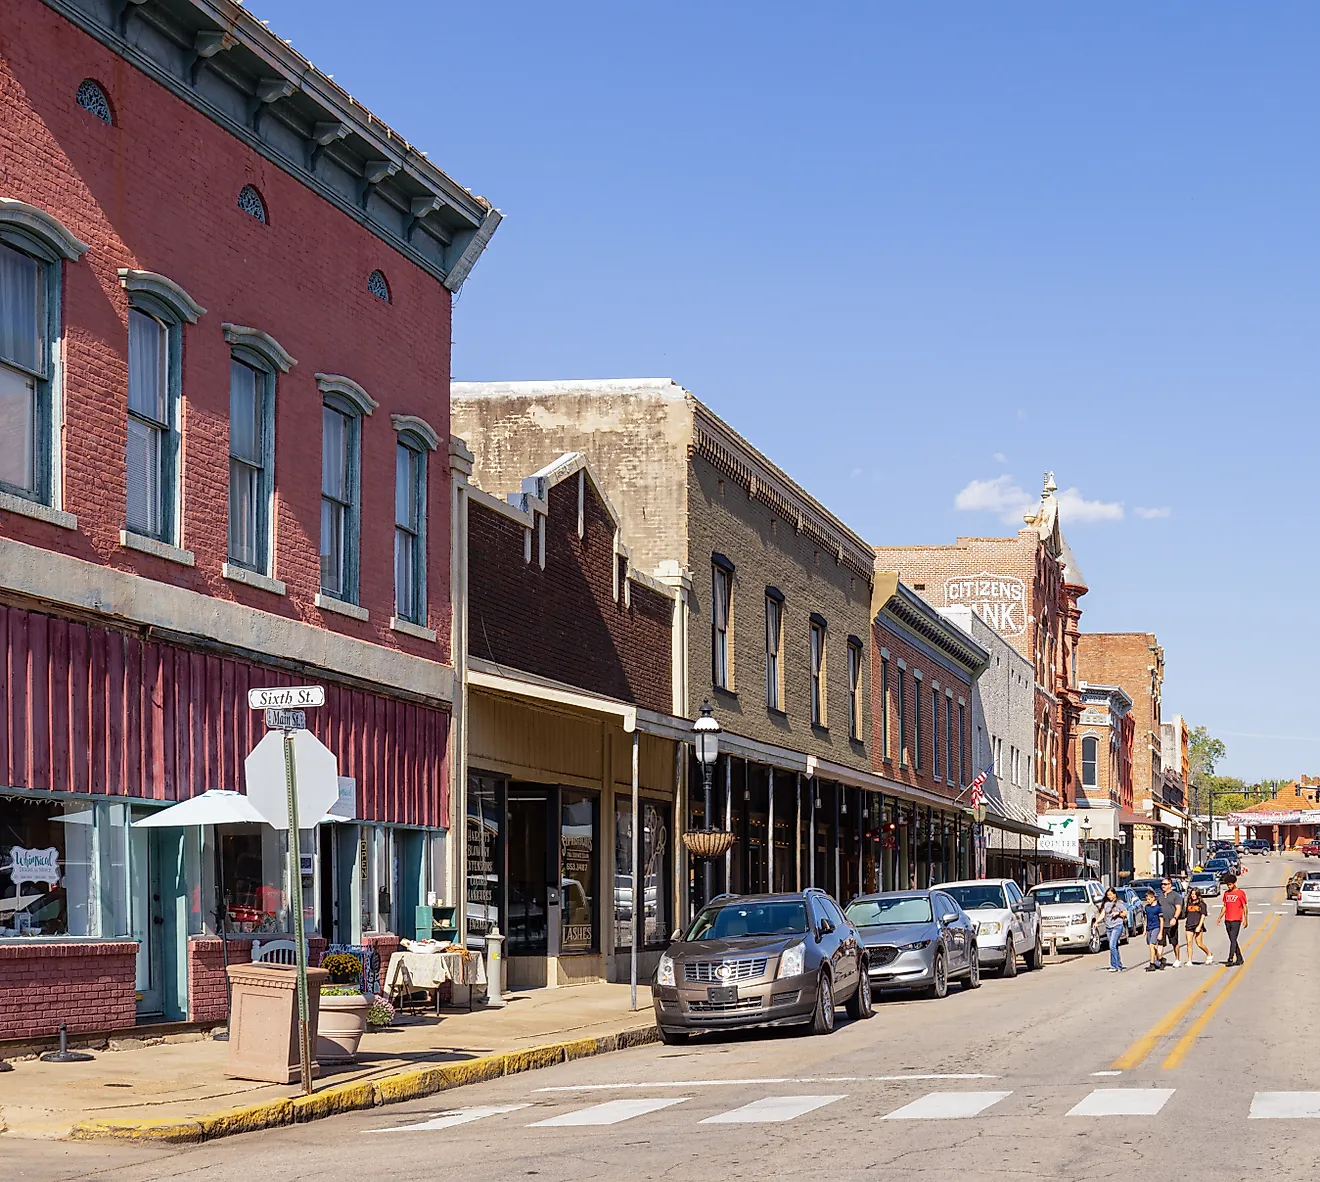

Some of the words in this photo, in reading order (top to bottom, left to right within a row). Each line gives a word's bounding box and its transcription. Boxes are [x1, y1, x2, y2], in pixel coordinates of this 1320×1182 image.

[949, 580, 1021, 600] CITIZENS
[260, 691, 293, 705] Sixth
[298, 690, 314, 704] St.
[272, 710, 291, 726] Main
[15, 851, 52, 868] Whimsical
[562, 926, 592, 944] LASHES
